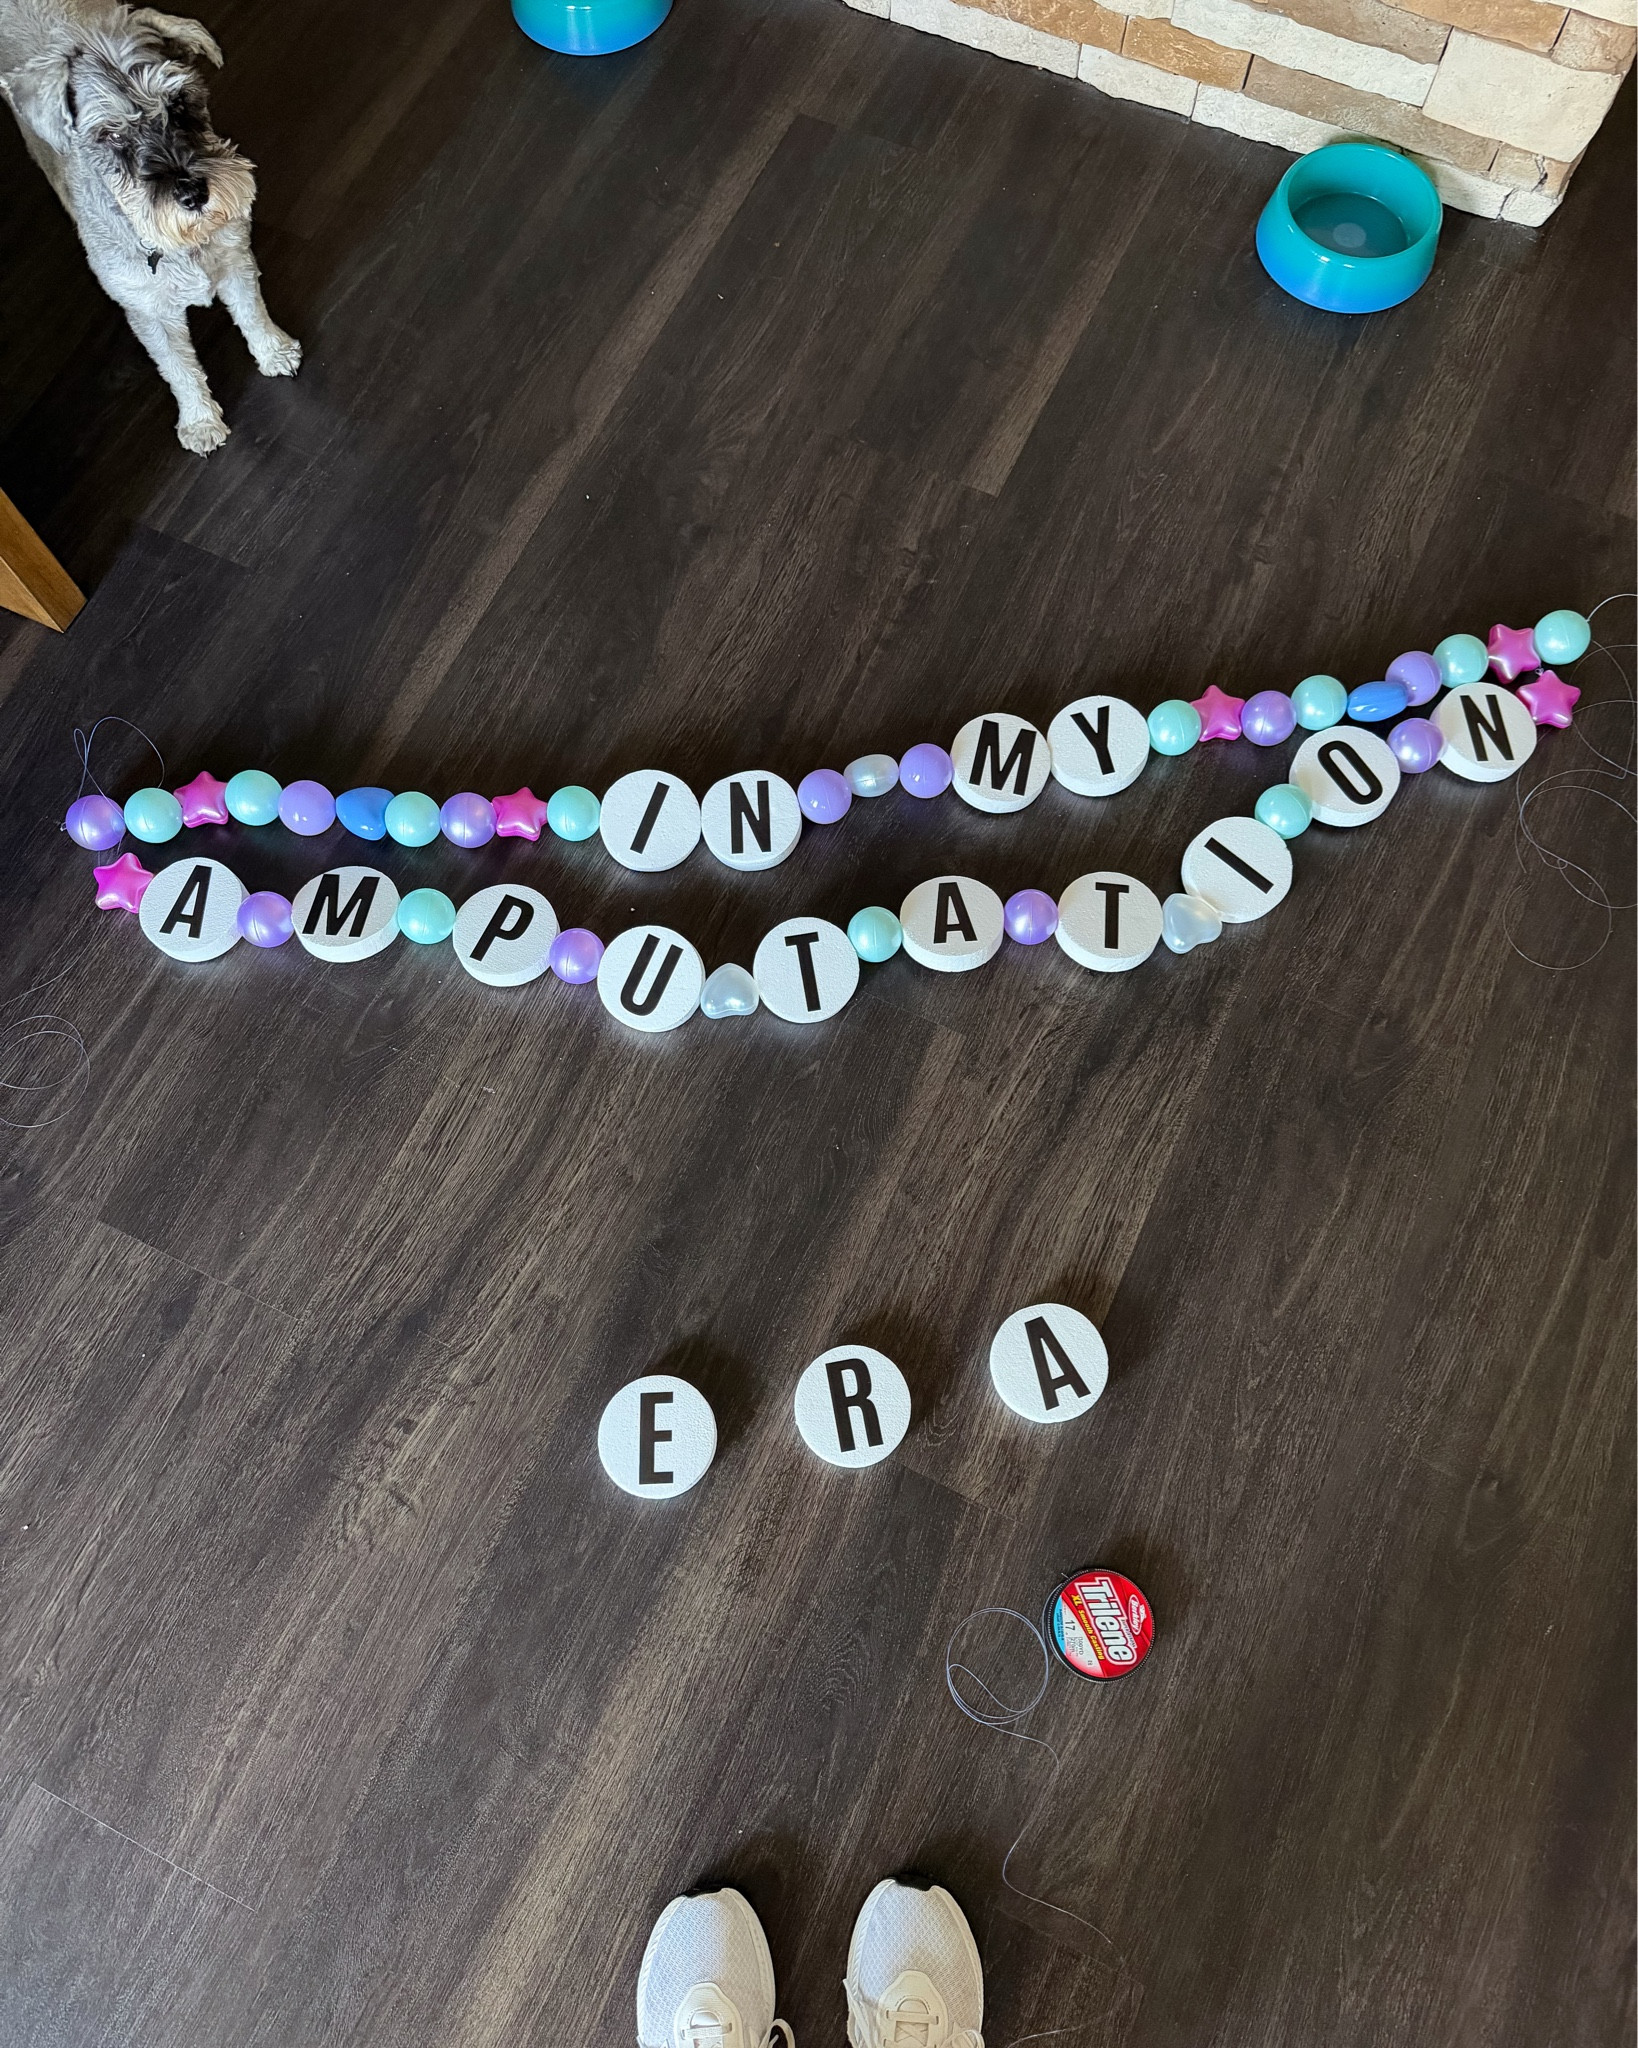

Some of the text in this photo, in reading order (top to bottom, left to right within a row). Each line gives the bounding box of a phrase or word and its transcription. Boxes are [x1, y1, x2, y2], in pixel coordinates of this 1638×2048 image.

[629, 705, 1116, 855] IN MY
[159, 694, 1515, 1016] AMPUTATION
[638, 1316, 1091, 1483] ERA
[1065, 1619, 1076, 1631] 17
[1071, 1594, 1105, 1660] XL Smooth Casting
[1080, 1581, 1134, 1661] Trilene
[1131, 1600, 1140, 1632] Berkley
